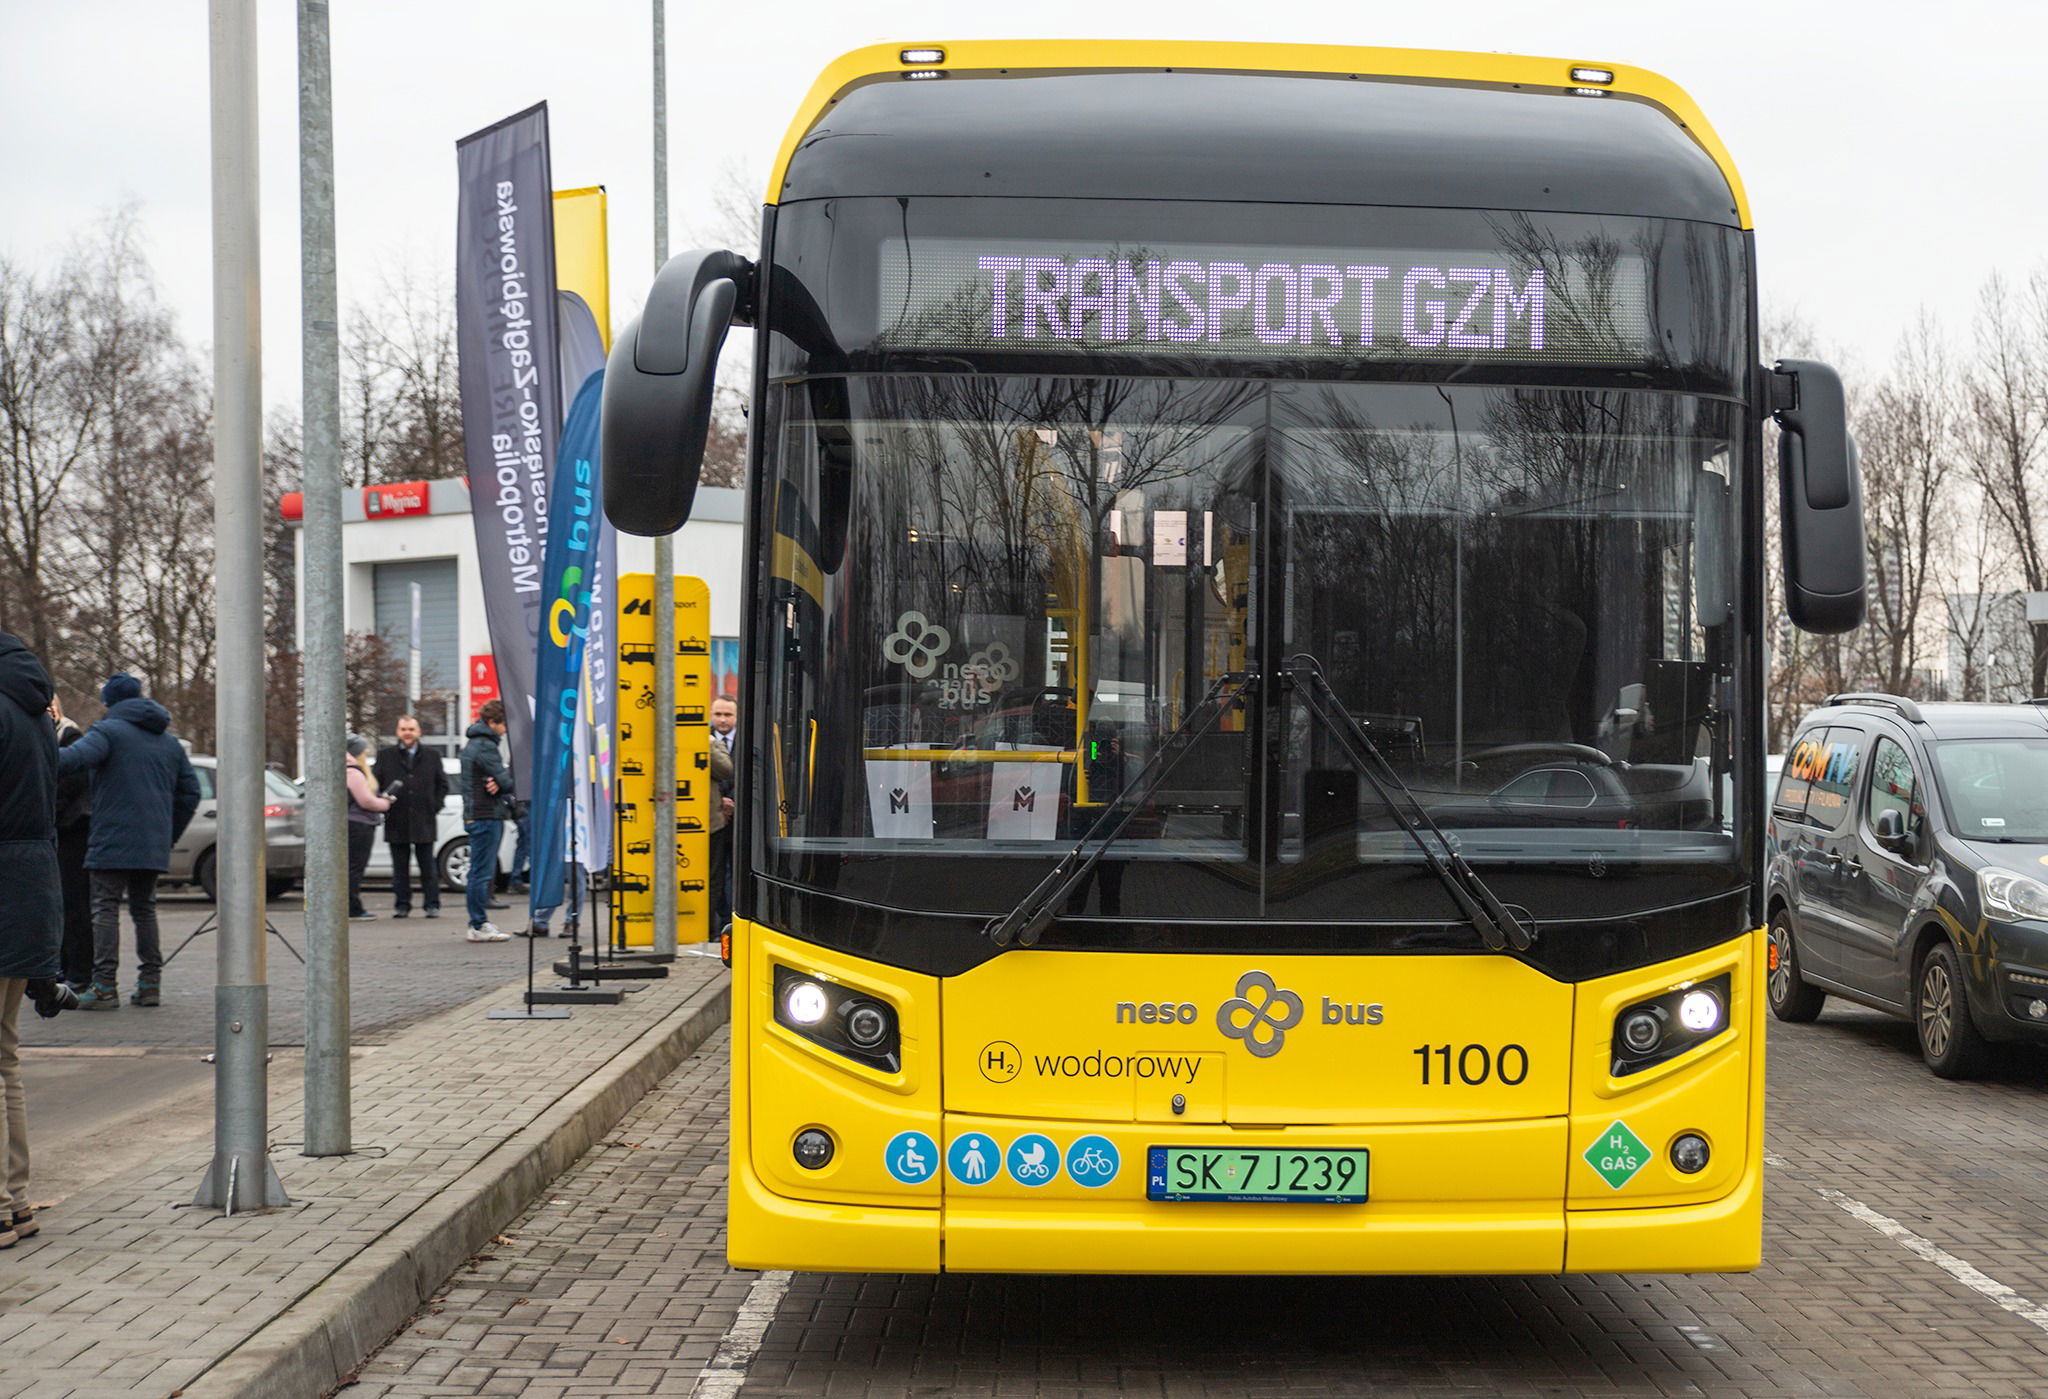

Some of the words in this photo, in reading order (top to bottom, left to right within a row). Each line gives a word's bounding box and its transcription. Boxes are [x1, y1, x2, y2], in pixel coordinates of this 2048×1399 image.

[978, 256, 1390, 346] TRANSPORT
[1403, 265, 1546, 349] GZM
[567, 459, 592, 552] bus
[943, 662, 1006, 680] neso
[943, 683, 992, 705] bus
[1115, 1000, 1198, 1025] neso
[1321, 996, 1384, 1025] bus
[1034, 1049, 1202, 1084] wodorowy
[1413, 1043, 1530, 1086] 1100
[1175, 1154, 1224, 1190] SK
[1240, 1154, 1357, 1192] 7J239
[1600, 1156, 1637, 1170] GAS
[1151, 1176, 1166, 1186] PL
